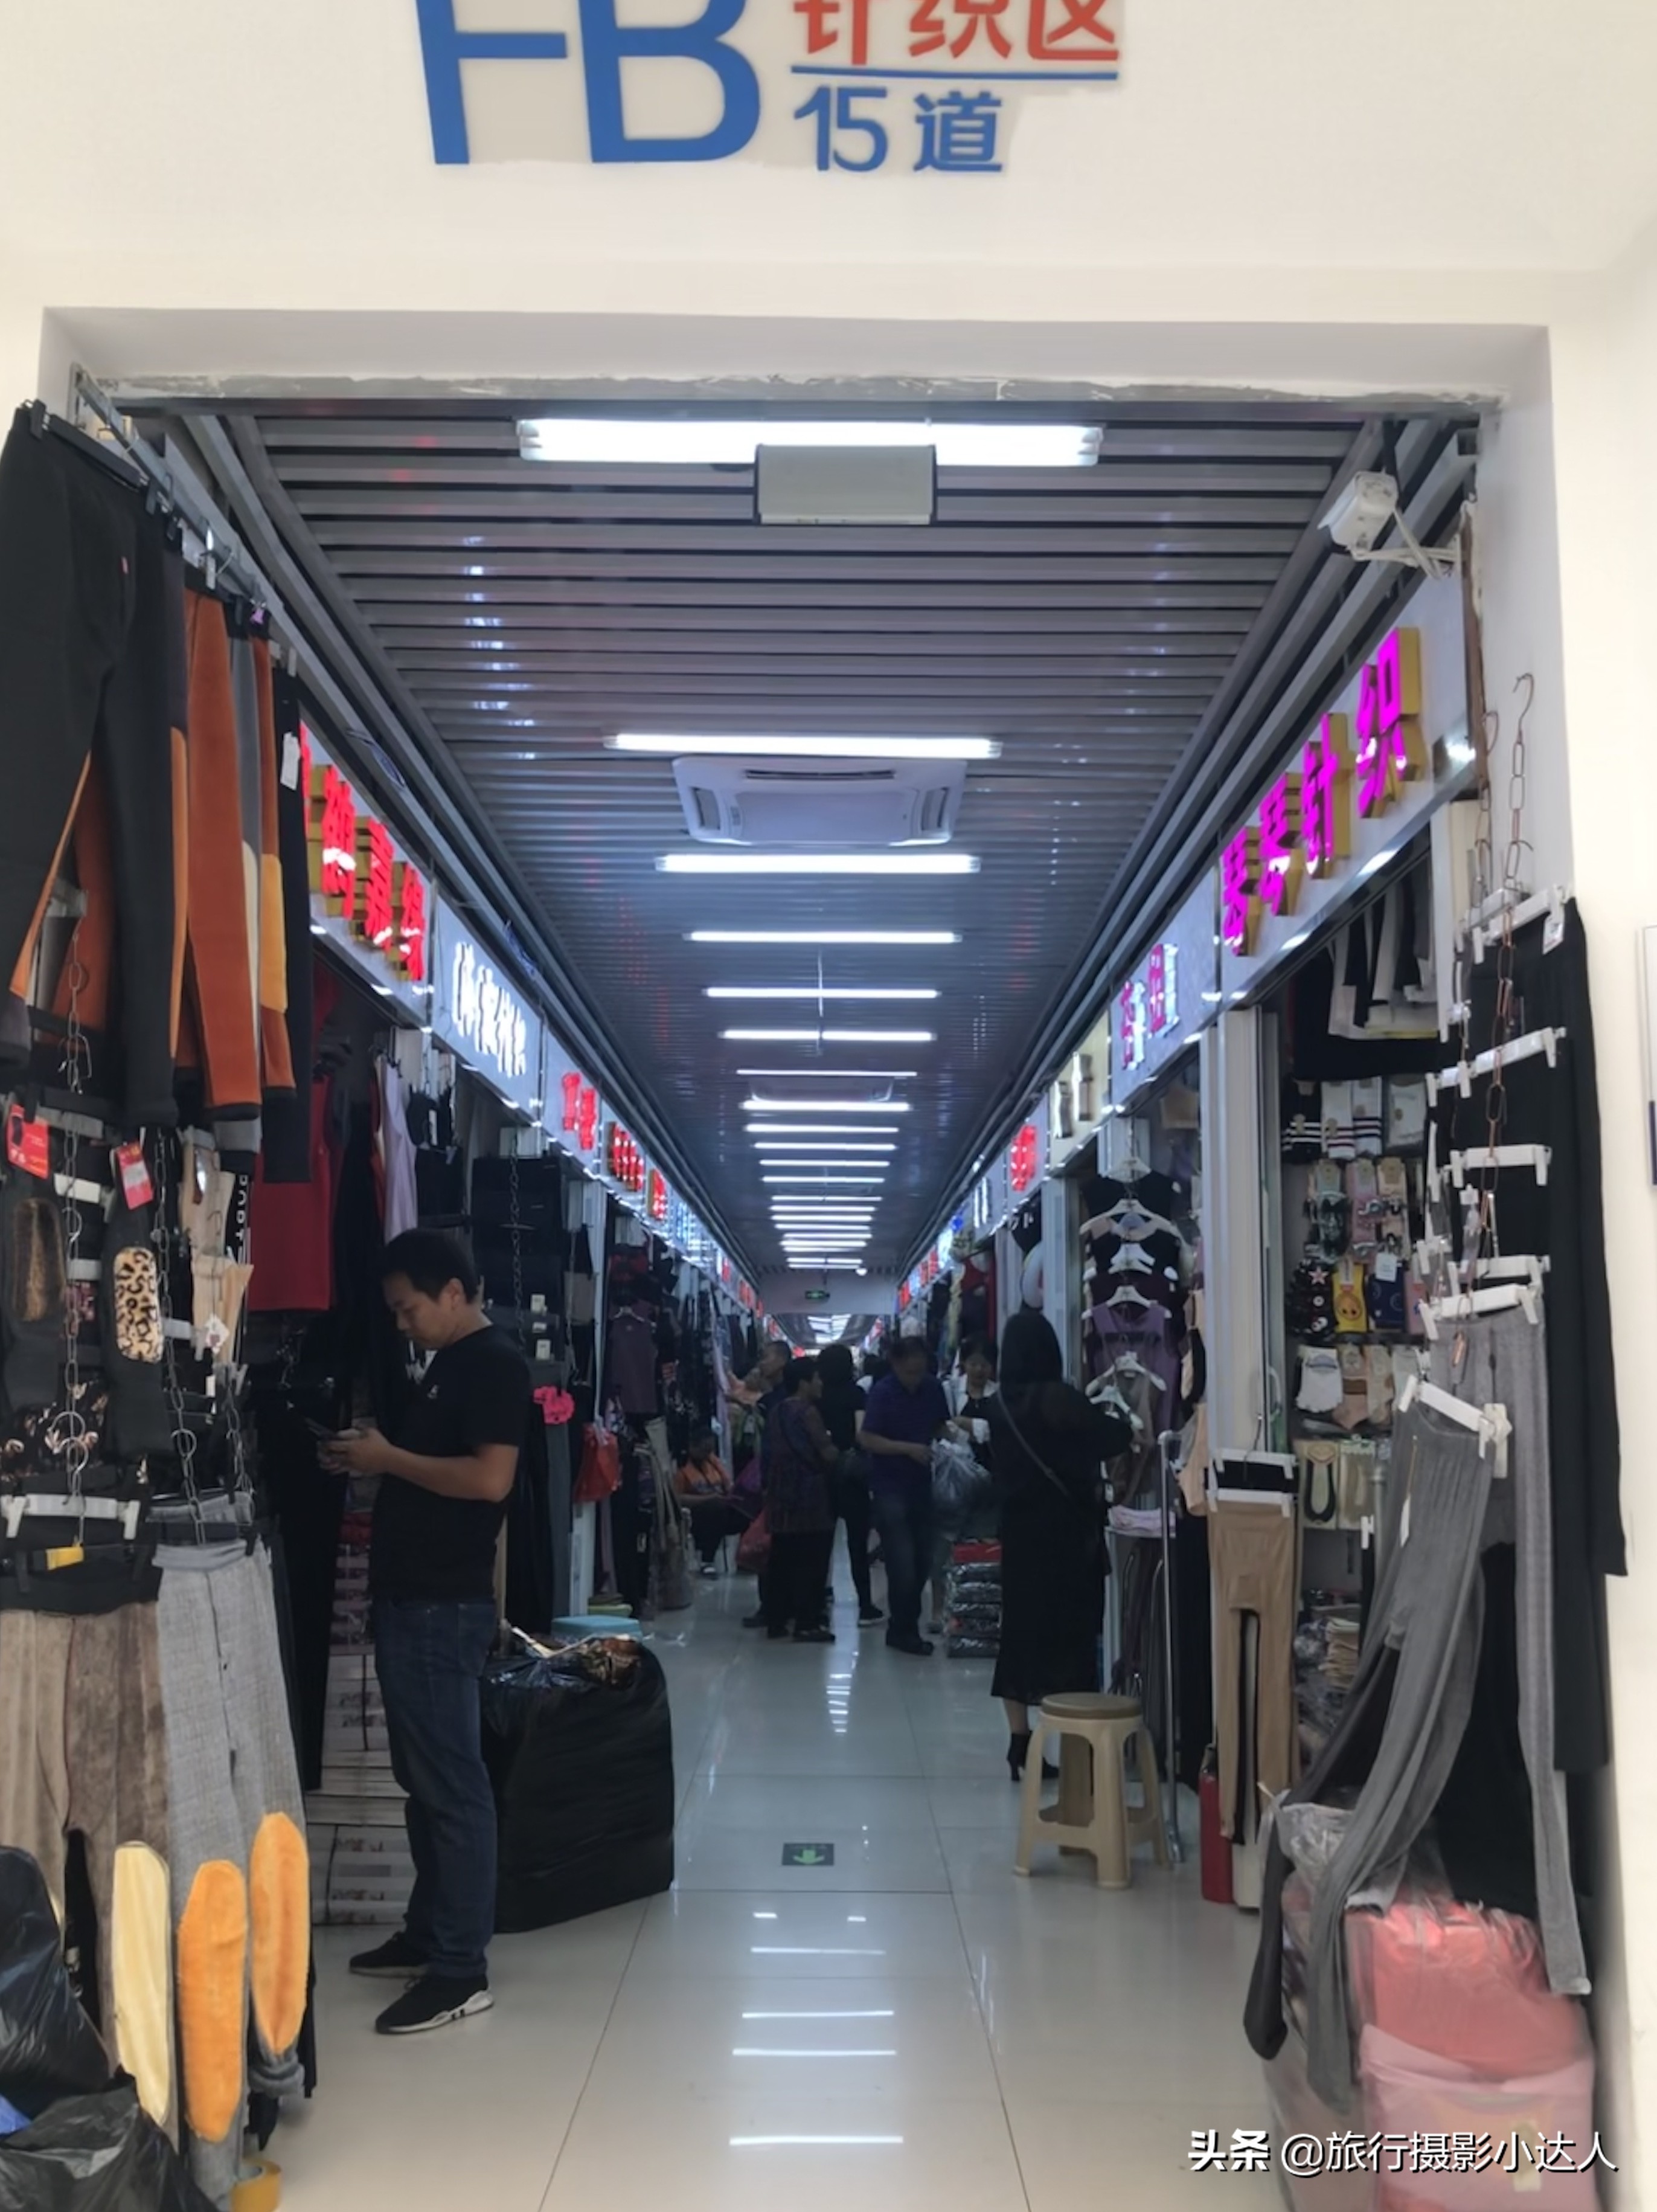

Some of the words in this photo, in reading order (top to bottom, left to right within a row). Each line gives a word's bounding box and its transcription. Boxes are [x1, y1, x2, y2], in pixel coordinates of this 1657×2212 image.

[794, 0, 1118, 65] 针织区
[794, 85, 1002, 173] 15道
